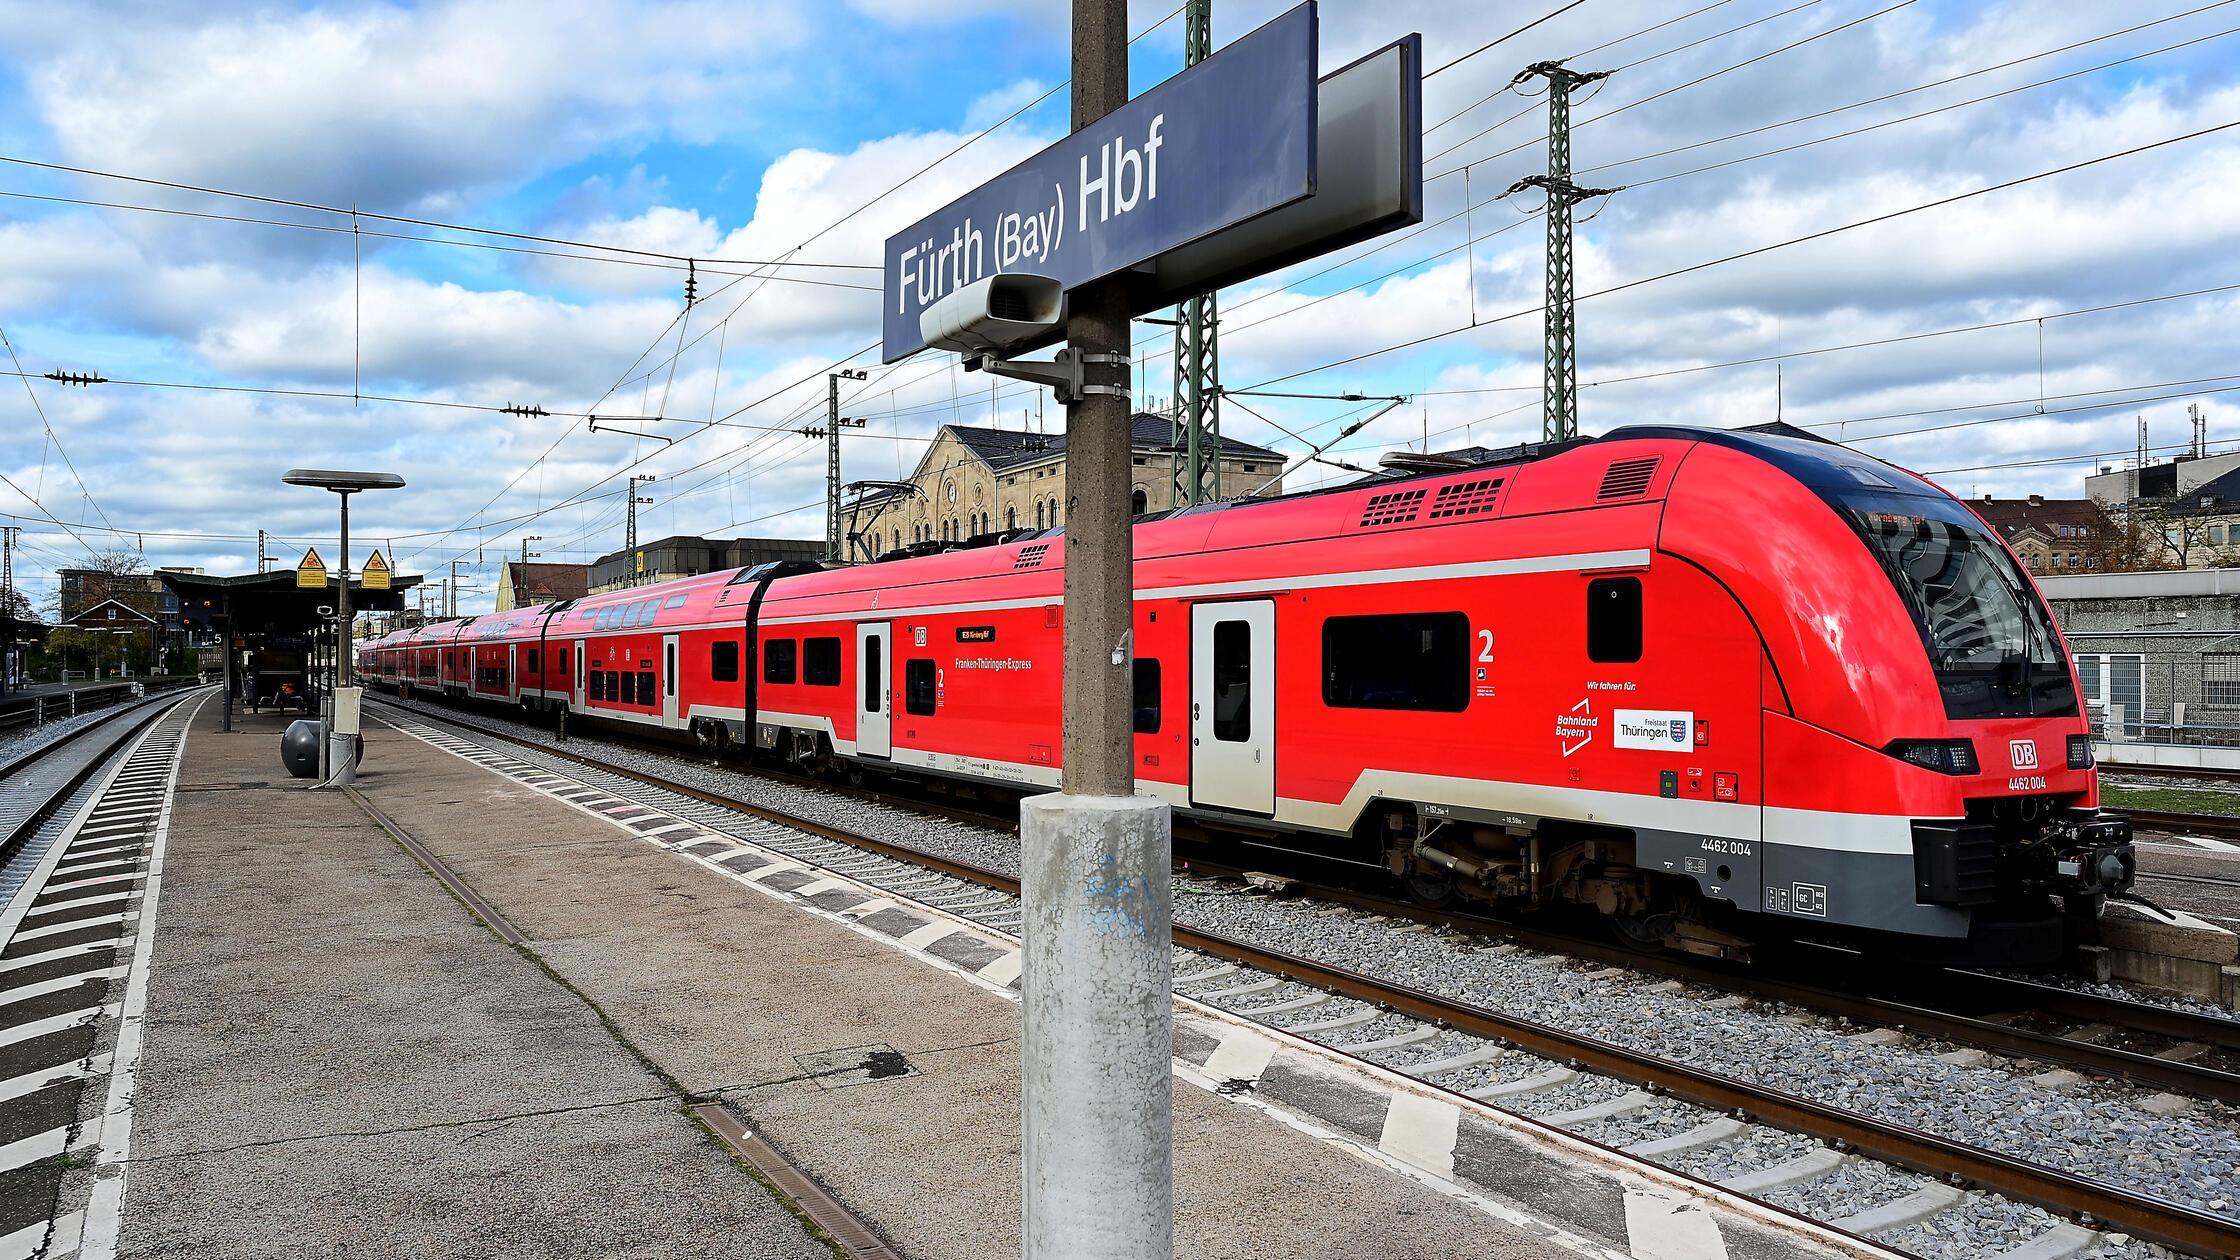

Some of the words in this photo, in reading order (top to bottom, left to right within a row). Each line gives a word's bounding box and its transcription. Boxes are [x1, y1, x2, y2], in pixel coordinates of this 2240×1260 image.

[899, 218, 983, 315] Fürth
[994, 183, 1064, 274] (Bay)
[1079, 113, 1164, 232] Hbf
[214, 633, 222, 644] 5
[915, 629, 926, 645] DB
[1478, 629, 1494, 662] 2
[955, 657, 1032, 671] Franken-Thüringen-Express
[938, 668, 944, 688] 2
[1587, 681, 1598, 690] Wir
[1600, 681, 1622, 690] fahren
[1624, 681, 1636, 691] für:
[1557, 715, 1598, 727] Bahnland
[1645, 719, 1668, 727] Freistaat
[1555, 726, 1585, 738] Bayern
[1620, 724, 1668, 741] Thüringen
[2012, 743, 2035, 766] DB
[2009, 777, 2030, 790] 4462
[2031, 776, 2047, 789] 004
[1701, 838, 1728, 853] 4462
[1730, 841, 1751, 856] 004
[1799, 894, 1808, 903] GC
